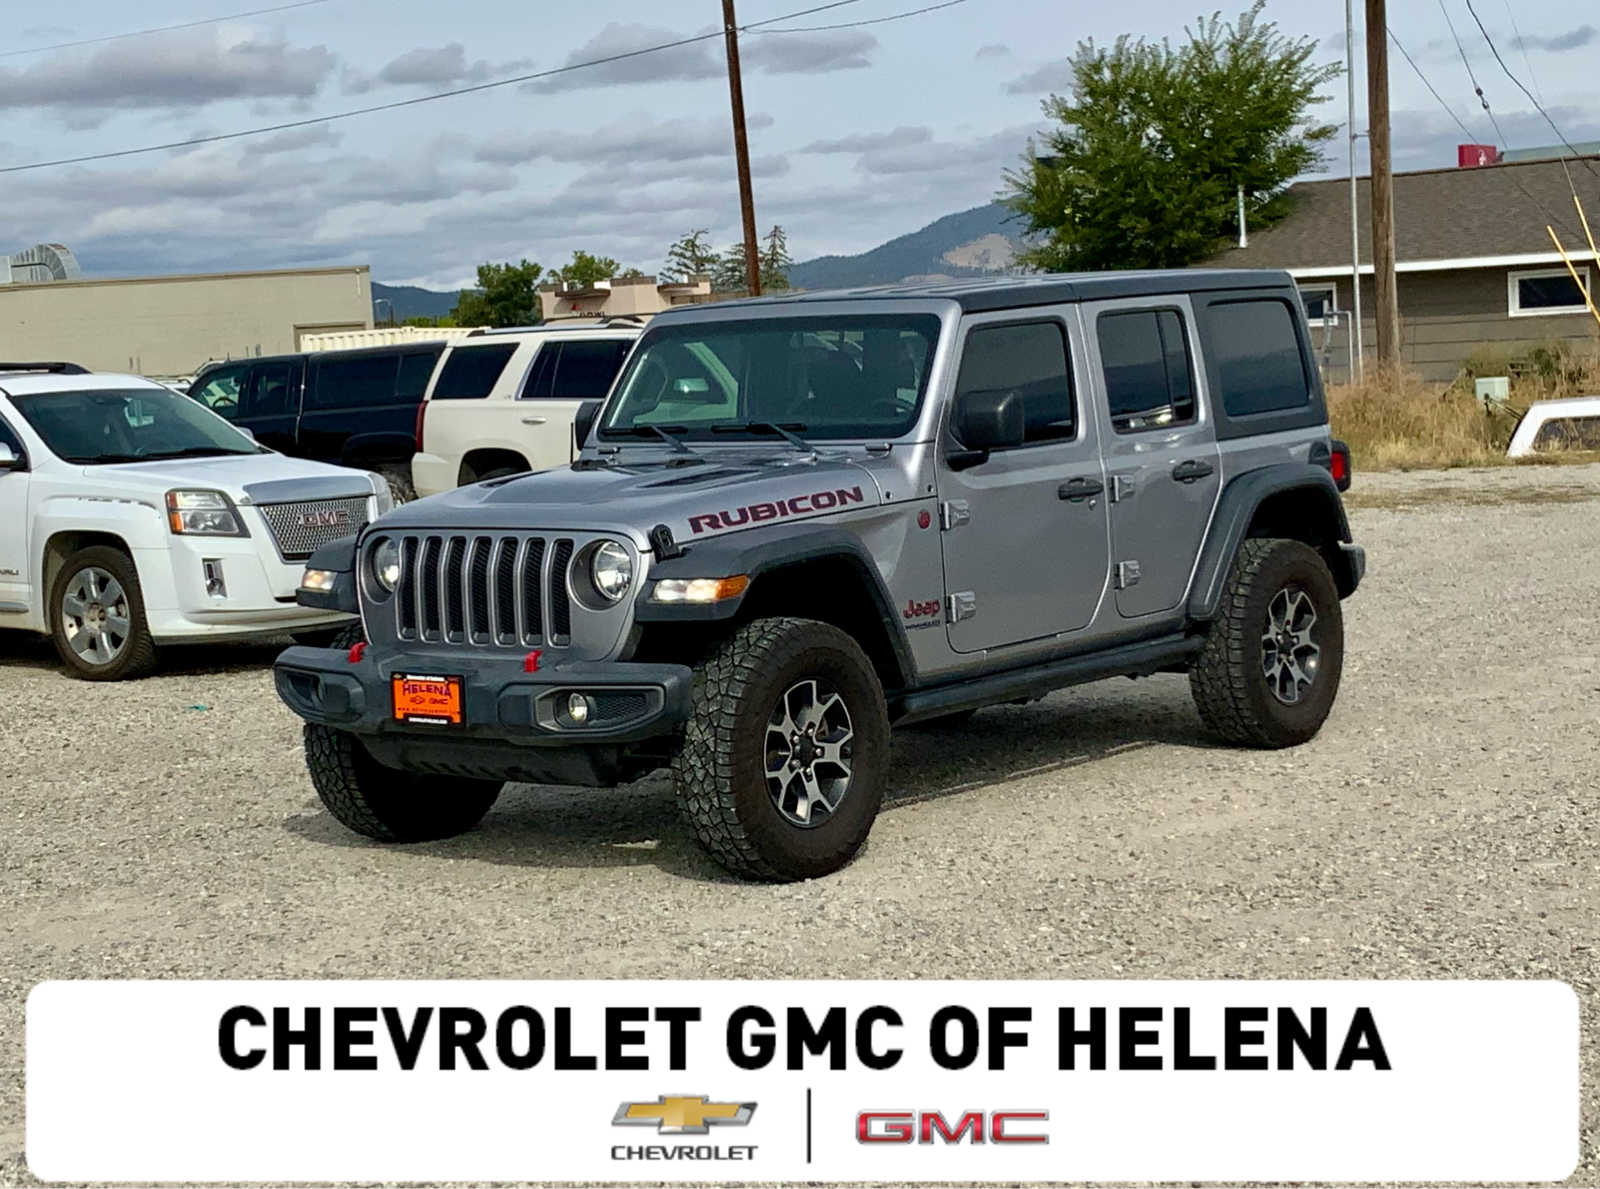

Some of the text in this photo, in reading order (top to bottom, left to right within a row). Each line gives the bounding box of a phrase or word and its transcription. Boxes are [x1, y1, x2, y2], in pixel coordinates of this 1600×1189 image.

[302, 510, 348, 527] GMC
[688, 486, 864, 534] RUBICON
[903, 599, 940, 618] Jeep
[402, 682, 452, 699] HELENA
